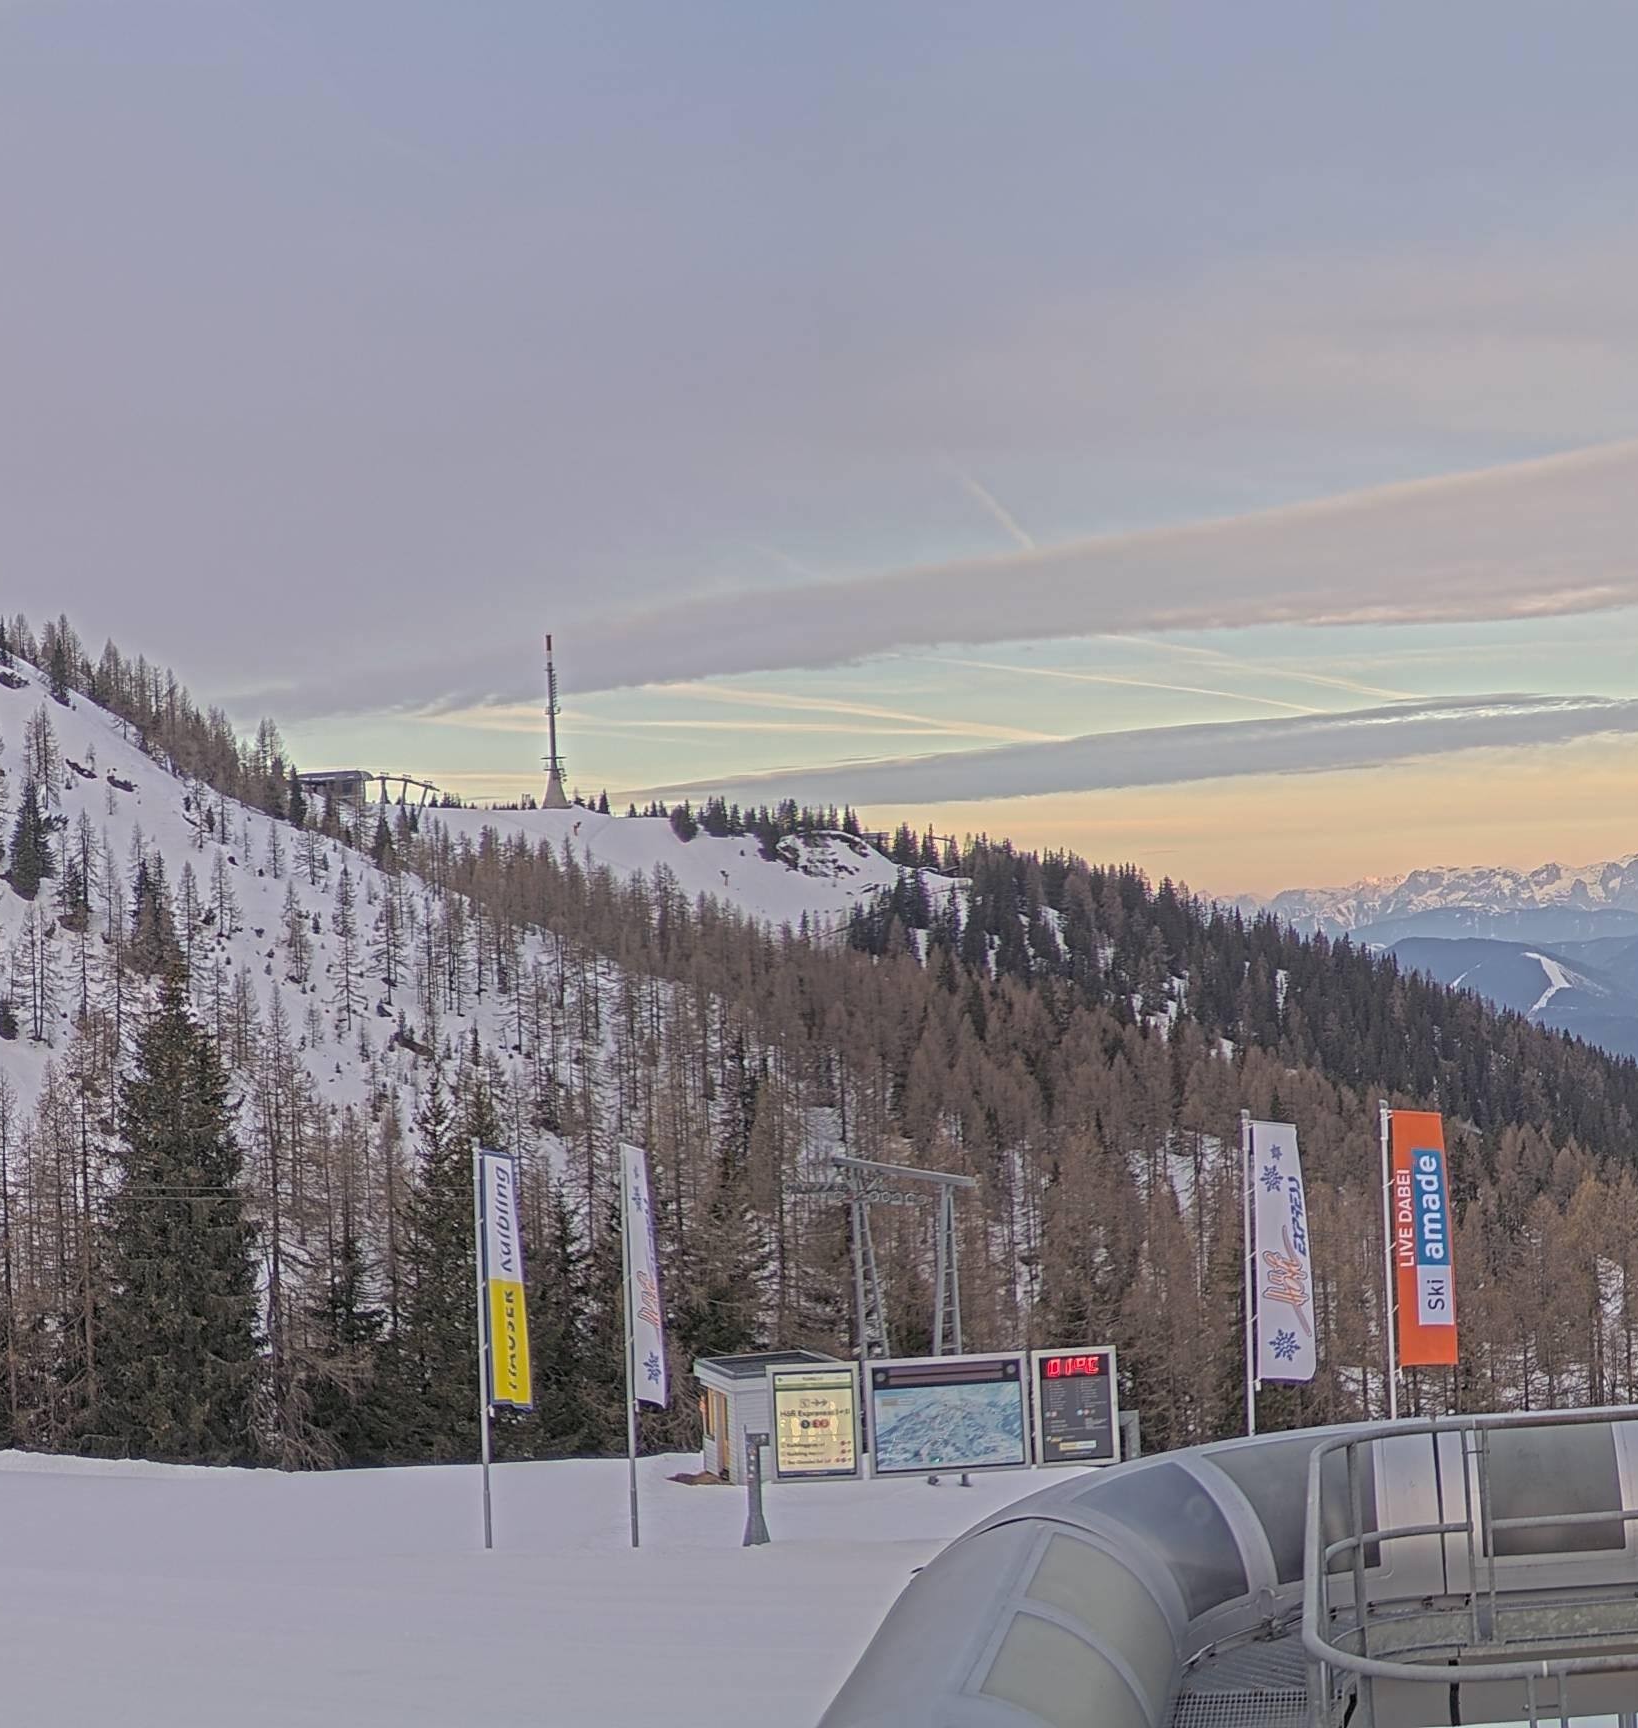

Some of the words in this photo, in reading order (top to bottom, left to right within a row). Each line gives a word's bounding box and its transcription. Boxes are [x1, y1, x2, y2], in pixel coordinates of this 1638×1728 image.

[1288, 1176, 1307, 1257] EXPRESS
[1396, 1169, 1414, 1226] DABEI
[1399, 1227, 1415, 1268] LIVE
[1427, 1279, 1445, 1311] Ski
